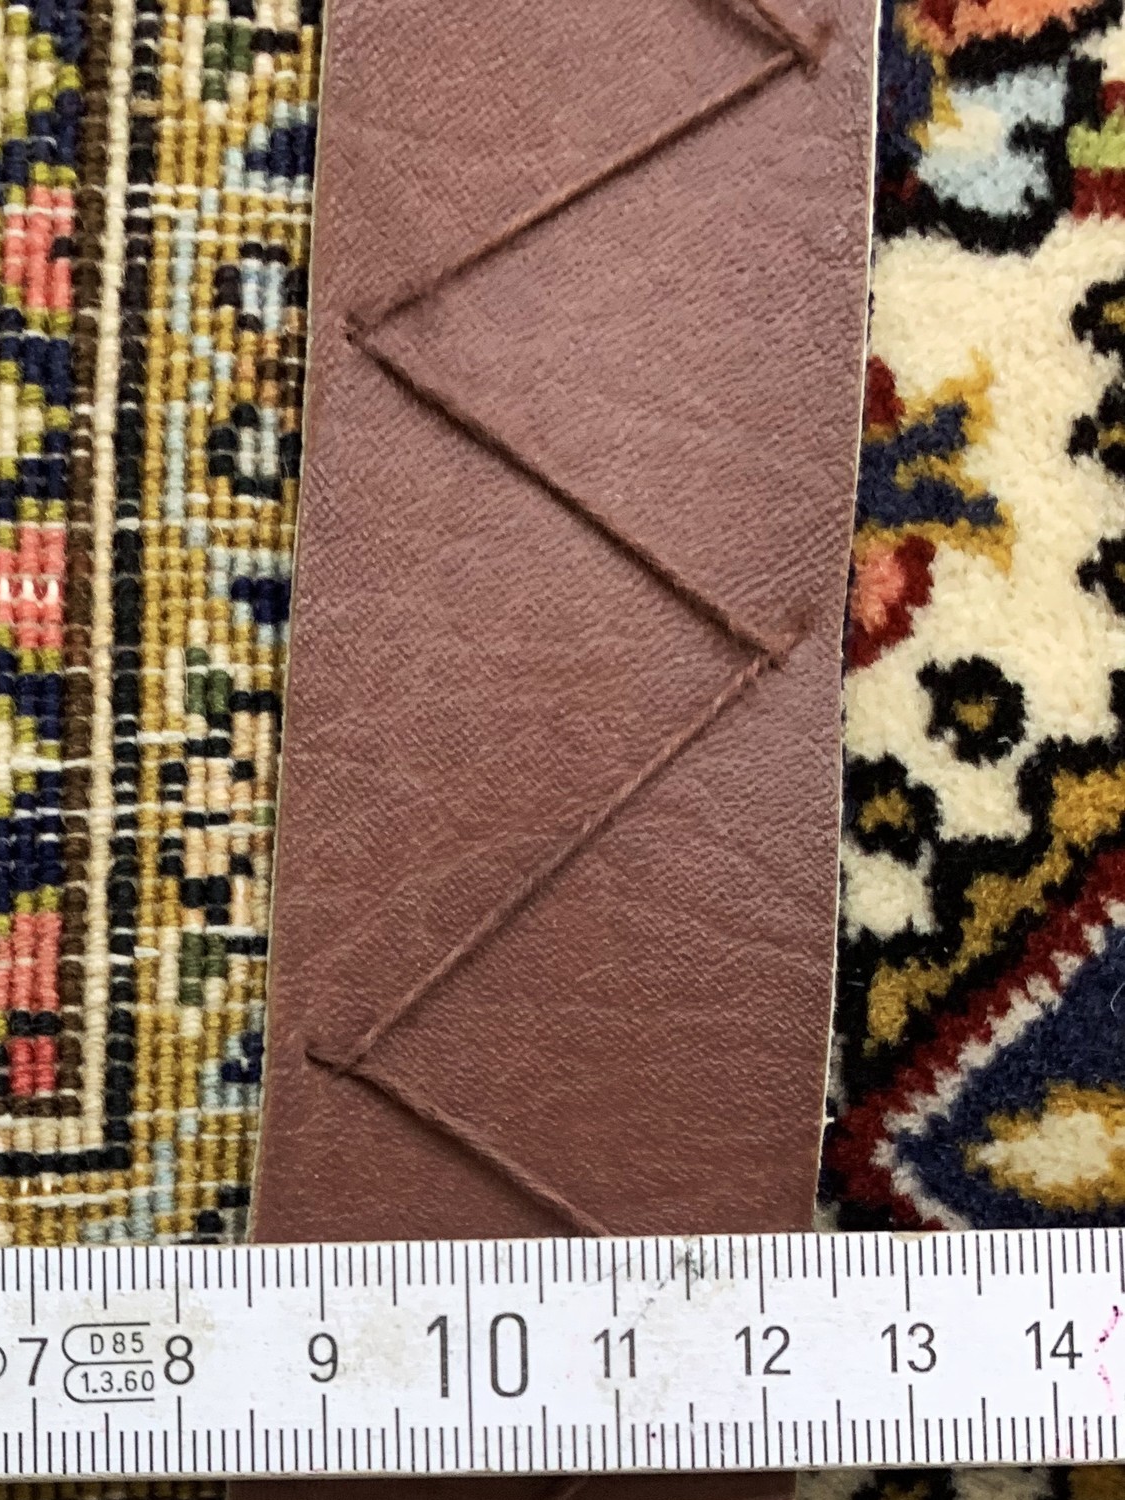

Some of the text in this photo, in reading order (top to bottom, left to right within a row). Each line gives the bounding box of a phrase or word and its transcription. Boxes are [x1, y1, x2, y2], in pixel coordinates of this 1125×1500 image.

[18, 1337, 49, 1387] 7
[163, 1335, 195, 1386] 8
[308, 1332, 339, 1383] 9
[426, 1312, 530, 1399] 10
[593, 1327, 637, 1378] 11
[734, 1325, 792, 1376] 12
[880, 1322, 938, 1373] 13
[1024, 1320, 1083, 1370] 14
[81, 1370, 155, 1394] 1.3.60
